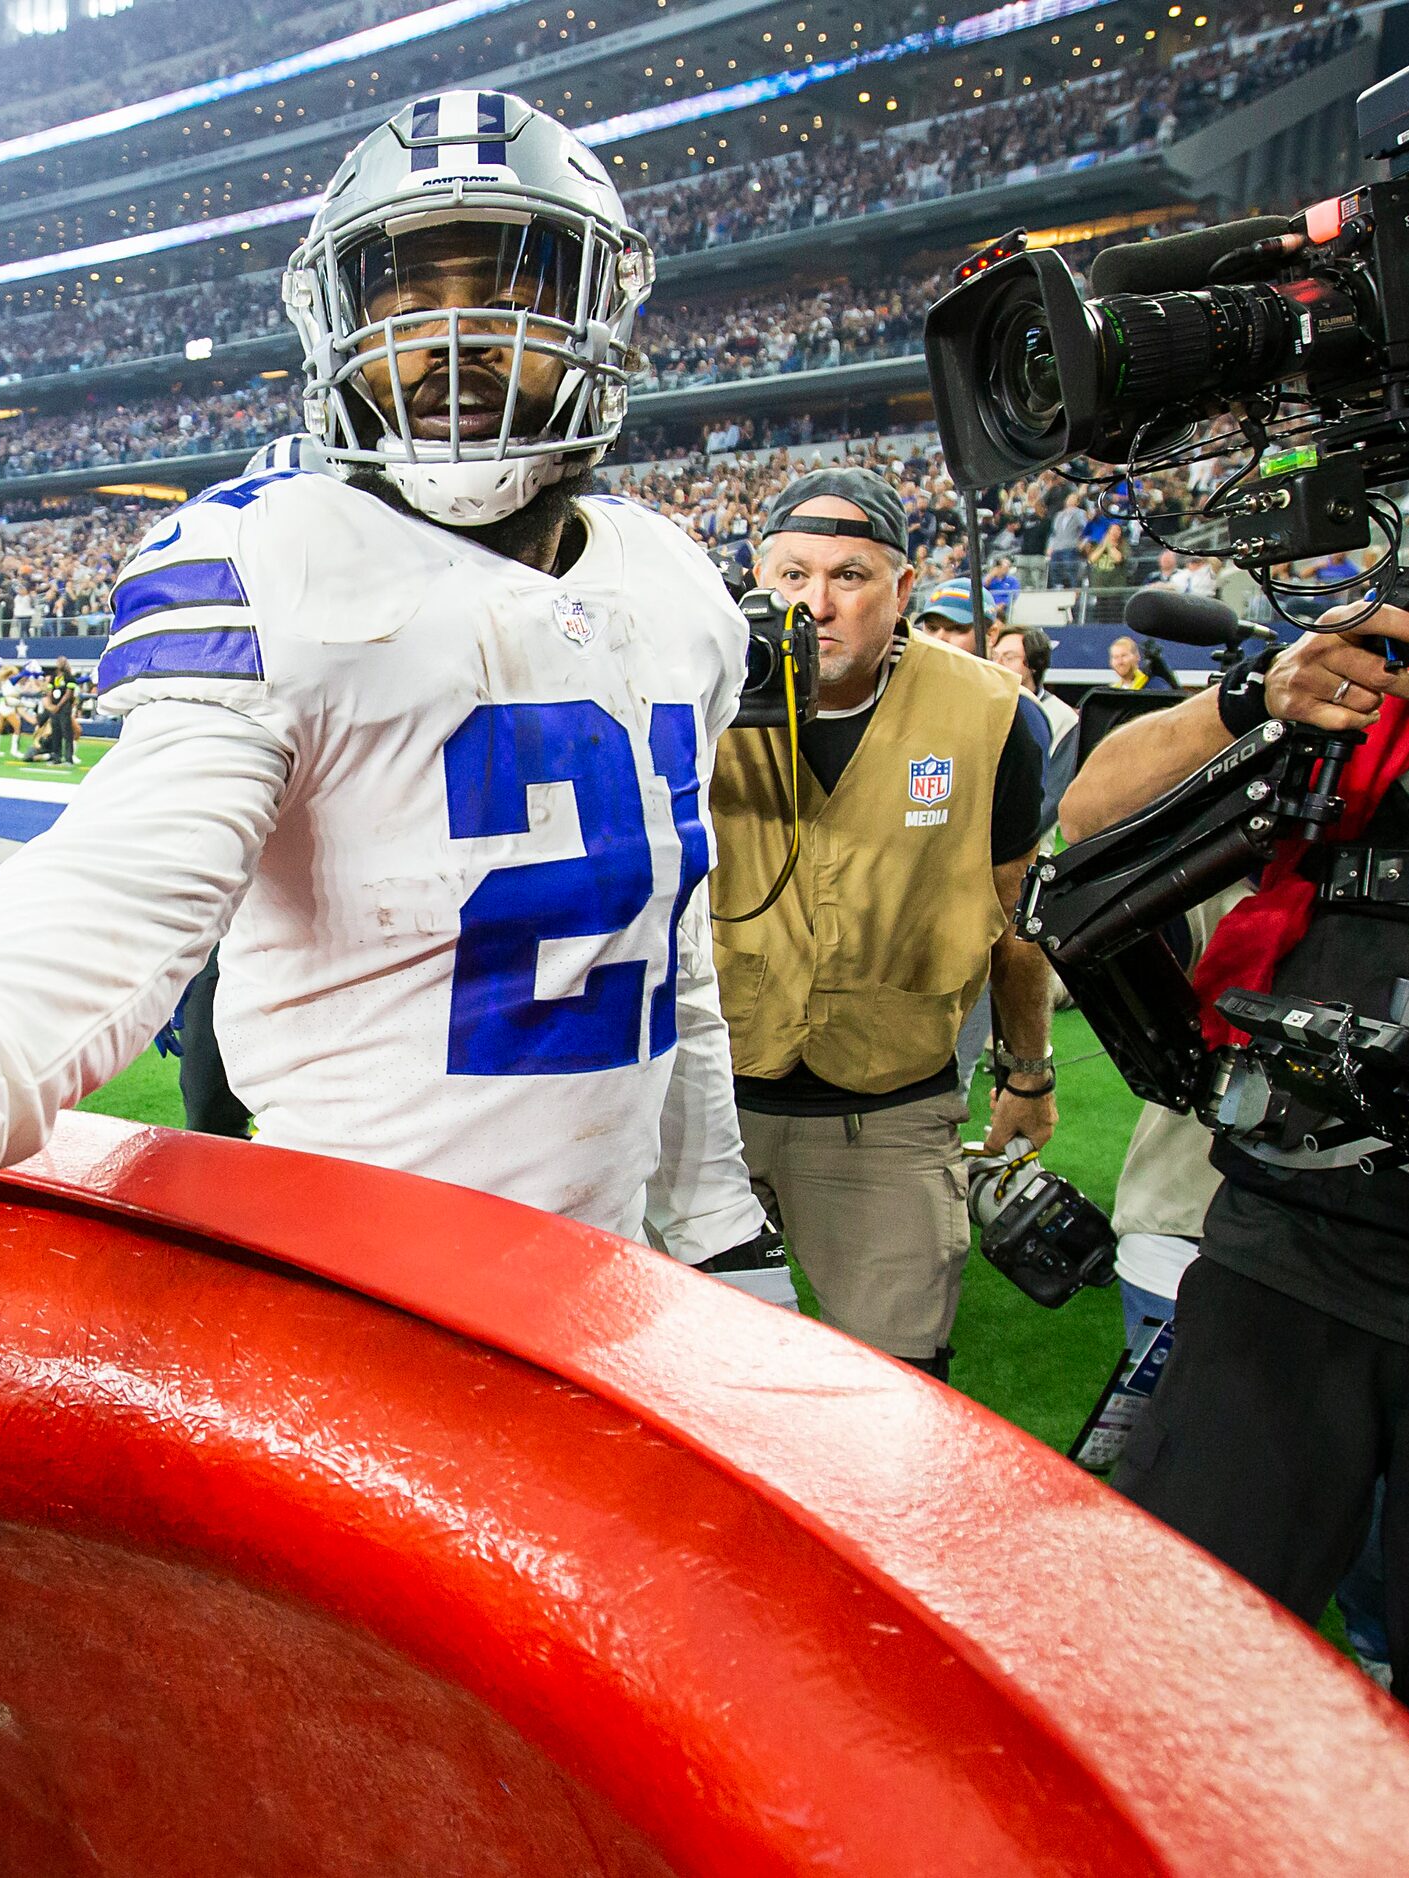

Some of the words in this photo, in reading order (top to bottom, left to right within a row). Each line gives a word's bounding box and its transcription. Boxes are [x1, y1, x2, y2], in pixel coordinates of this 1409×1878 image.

[742, 606, 768, 615] Canon
[565, 616, 589, 636] NFL
[1207, 742, 1257, 783] PRO
[914, 776, 946, 799] NFL
[905, 808, 949, 828] MEDIA
[443, 699, 709, 1076] 21
